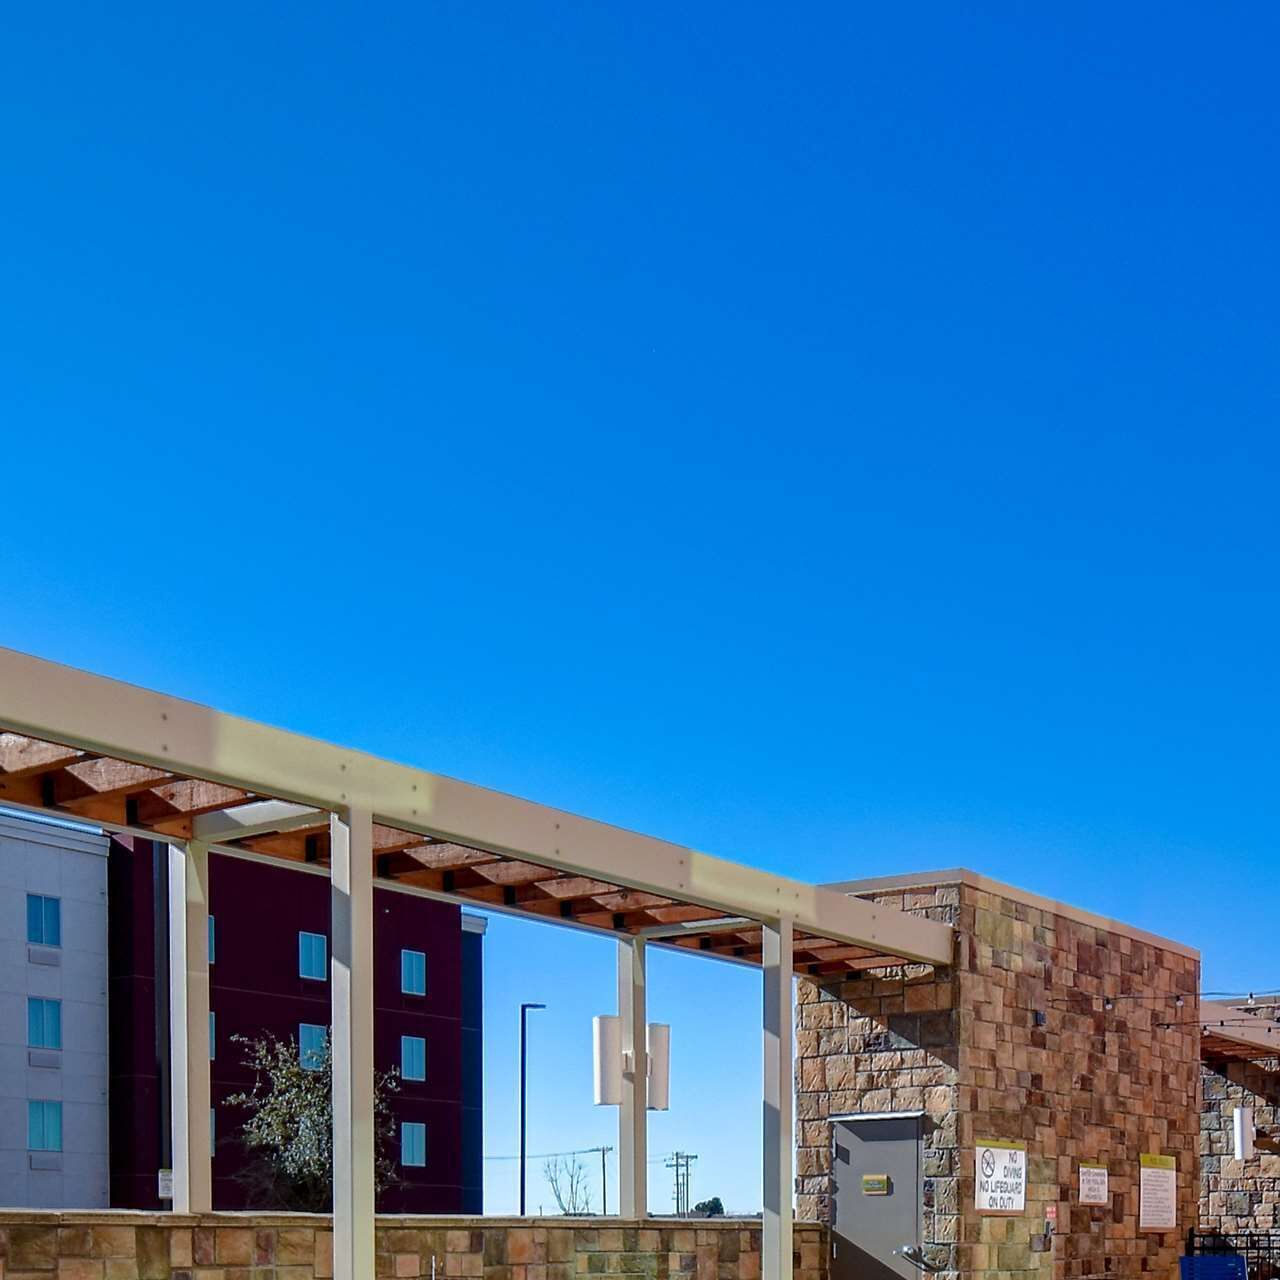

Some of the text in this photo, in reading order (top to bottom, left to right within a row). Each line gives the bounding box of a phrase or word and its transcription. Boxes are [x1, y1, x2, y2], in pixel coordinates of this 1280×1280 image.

[1009, 1151, 1018, 1164] NO
[1003, 1166, 1022, 1179] DIVING
[979, 1181, 1022, 1194] NO LIFEGUARD
[988, 1196, 1014, 1208] ON DUTY
